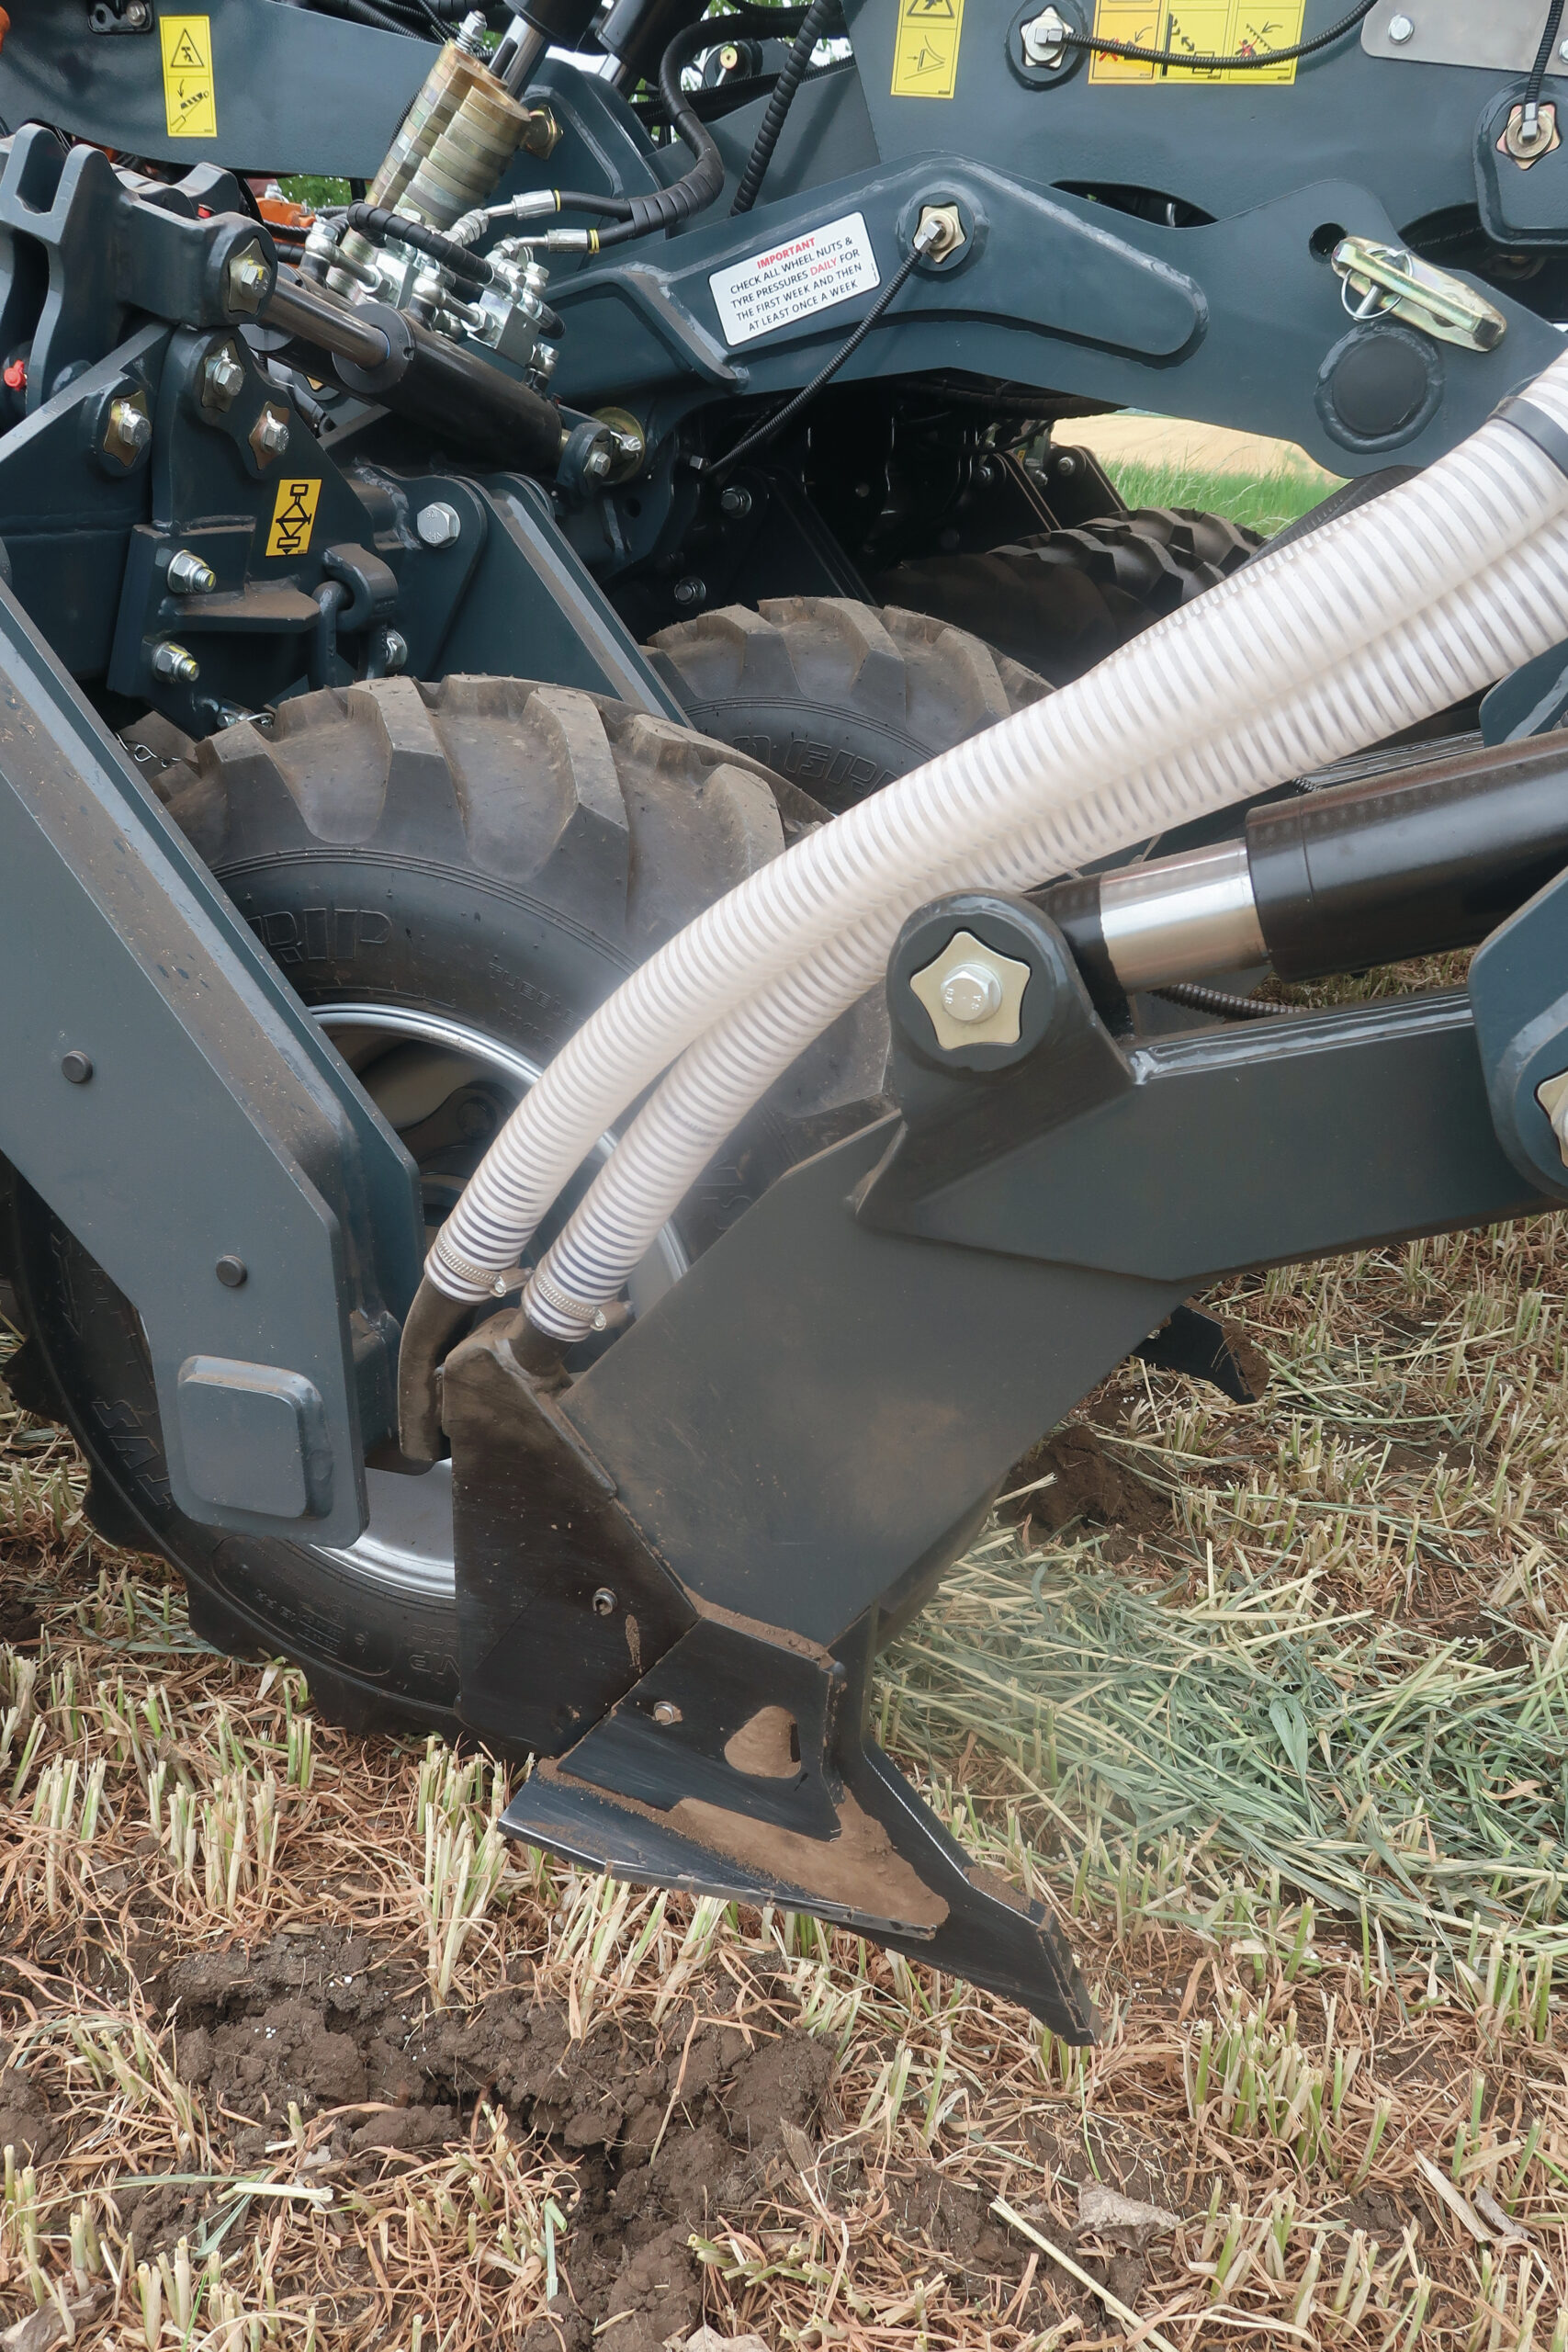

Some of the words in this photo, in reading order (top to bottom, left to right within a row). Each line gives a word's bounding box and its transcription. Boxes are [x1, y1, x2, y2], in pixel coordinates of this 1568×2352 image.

[730, 276, 761, 294] CHECK
[763, 267, 781, 281] ALL
[781, 254, 815, 272] WHEEL
[816, 240, 843, 258] NUTS
[845, 236, 853, 245] &
[730, 292, 754, 309] TYRE
[756, 270, 808, 299] PRESSURES
[810, 257, 837, 276] DAILY
[840, 248, 860, 263] FOR
[757, 237, 815, 269] IMPORTANT
[736, 307, 754, 322] THE
[756, 297, 781, 311] FIRST
[783, 284, 810, 302] WEEK
[813, 275, 834, 290] AND
[836, 262, 862, 280] THEN
[749, 320, 760, 332] AT
[761, 307, 789, 326] LEAST
[792, 296, 818, 313] ONCE
[821, 292, 829, 302] A
[829, 279, 859, 297] WEEK
